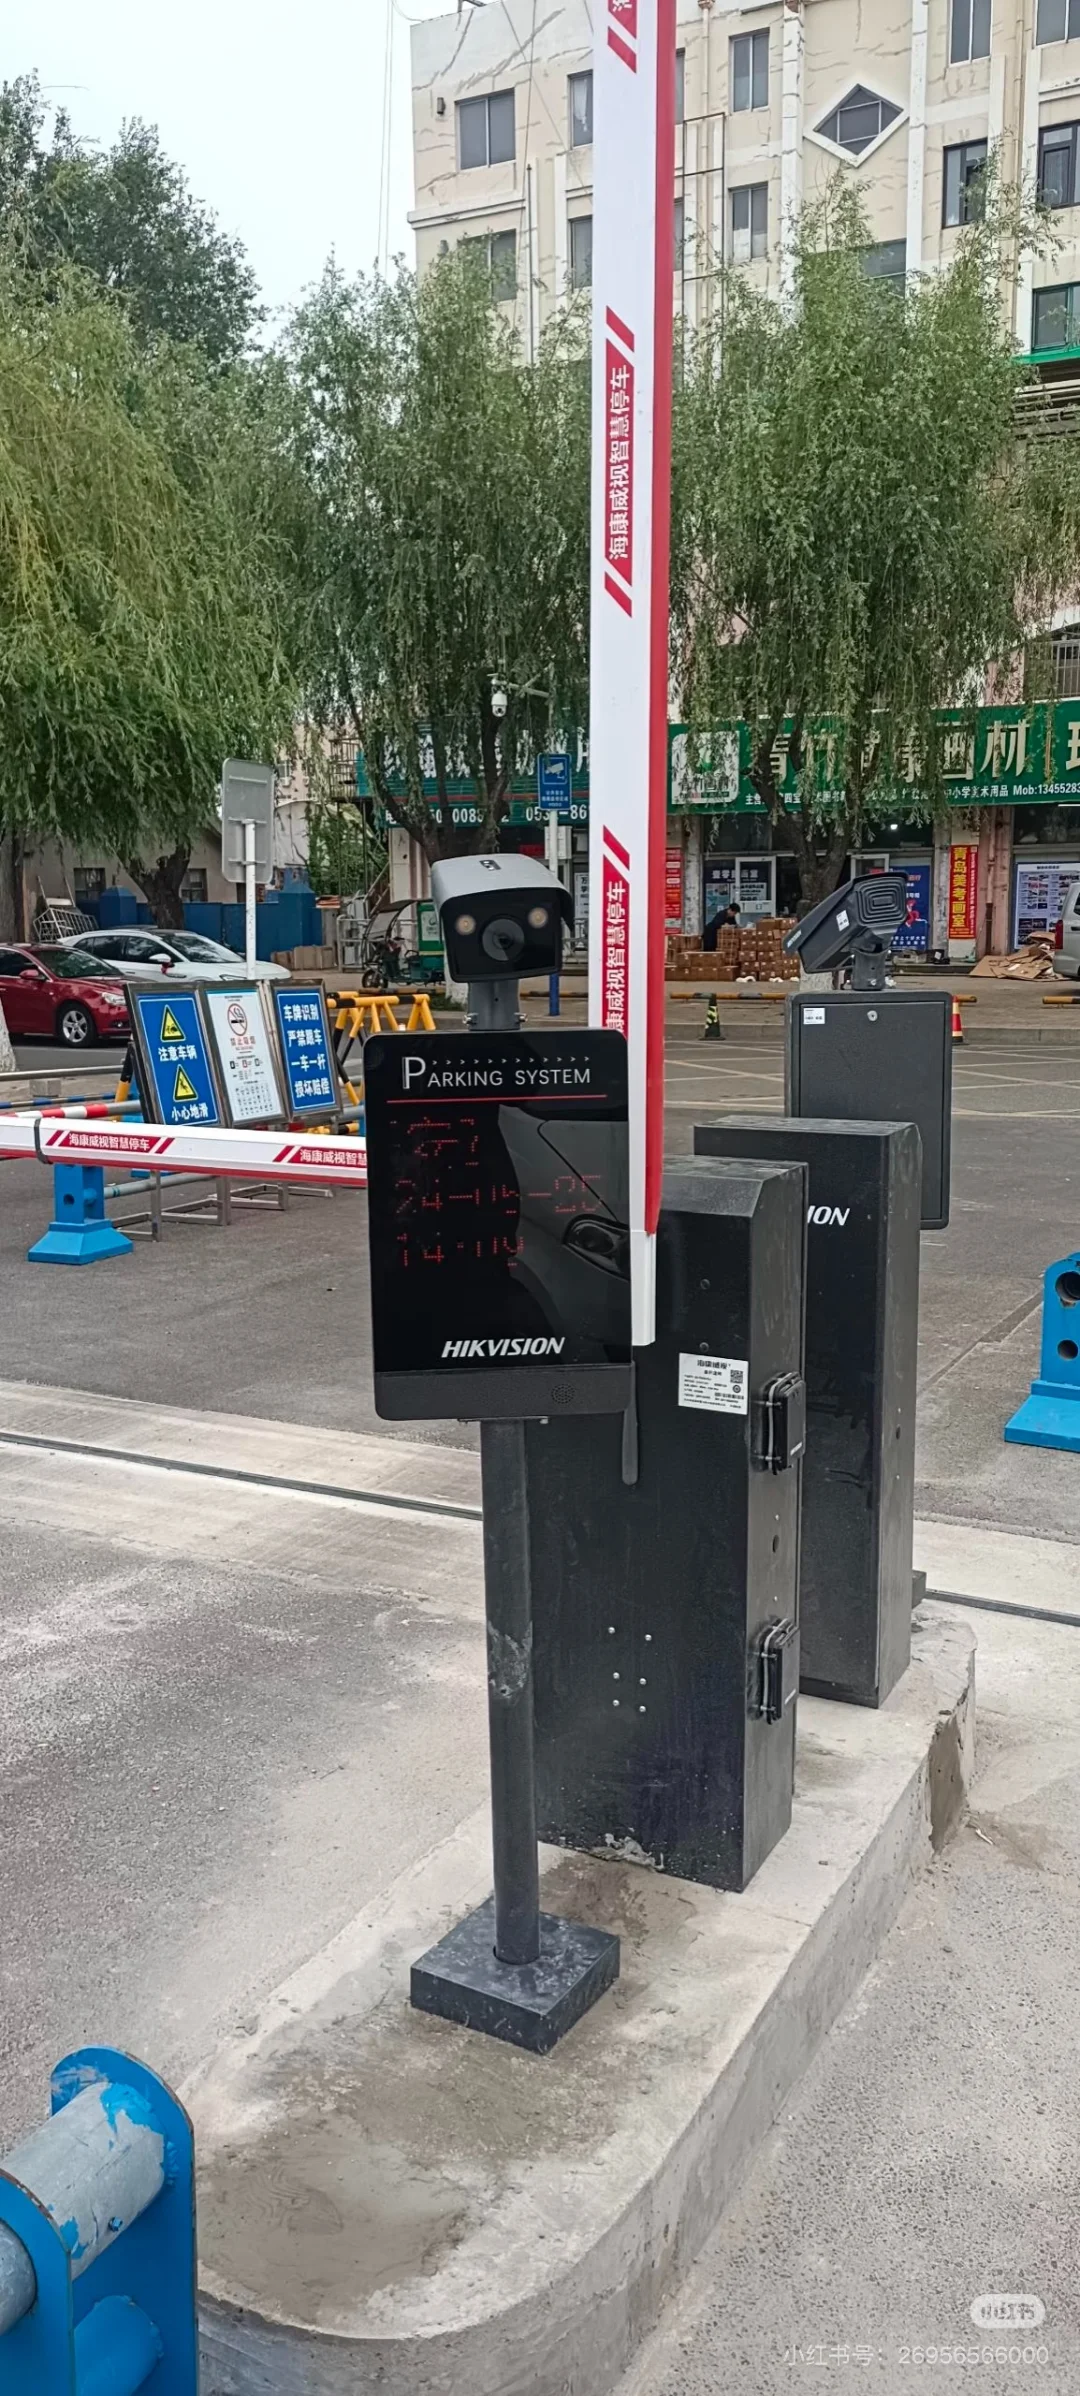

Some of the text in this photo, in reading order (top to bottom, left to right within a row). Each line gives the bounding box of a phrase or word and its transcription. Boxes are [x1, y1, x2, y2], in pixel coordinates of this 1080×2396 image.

[608, 364, 631, 559] 海康威视智慧停车
[283, 1003, 320, 1022] 车牌识别
[286, 1028, 323, 1048] 严禁跟车
[157, 1044, 198, 1062] 注意车辆
[290, 1053, 326, 1072] 一车一杆
[401, 1056, 591, 1090] PARKING SYSTEM
[294, 1077, 331, 1099] 损坏赔偿
[170, 1101, 209, 1122] 小心地滑
[68, 1132, 150, 1152] 海康威视智慧停车
[440, 1336, 567, 1359] HIKVISION
